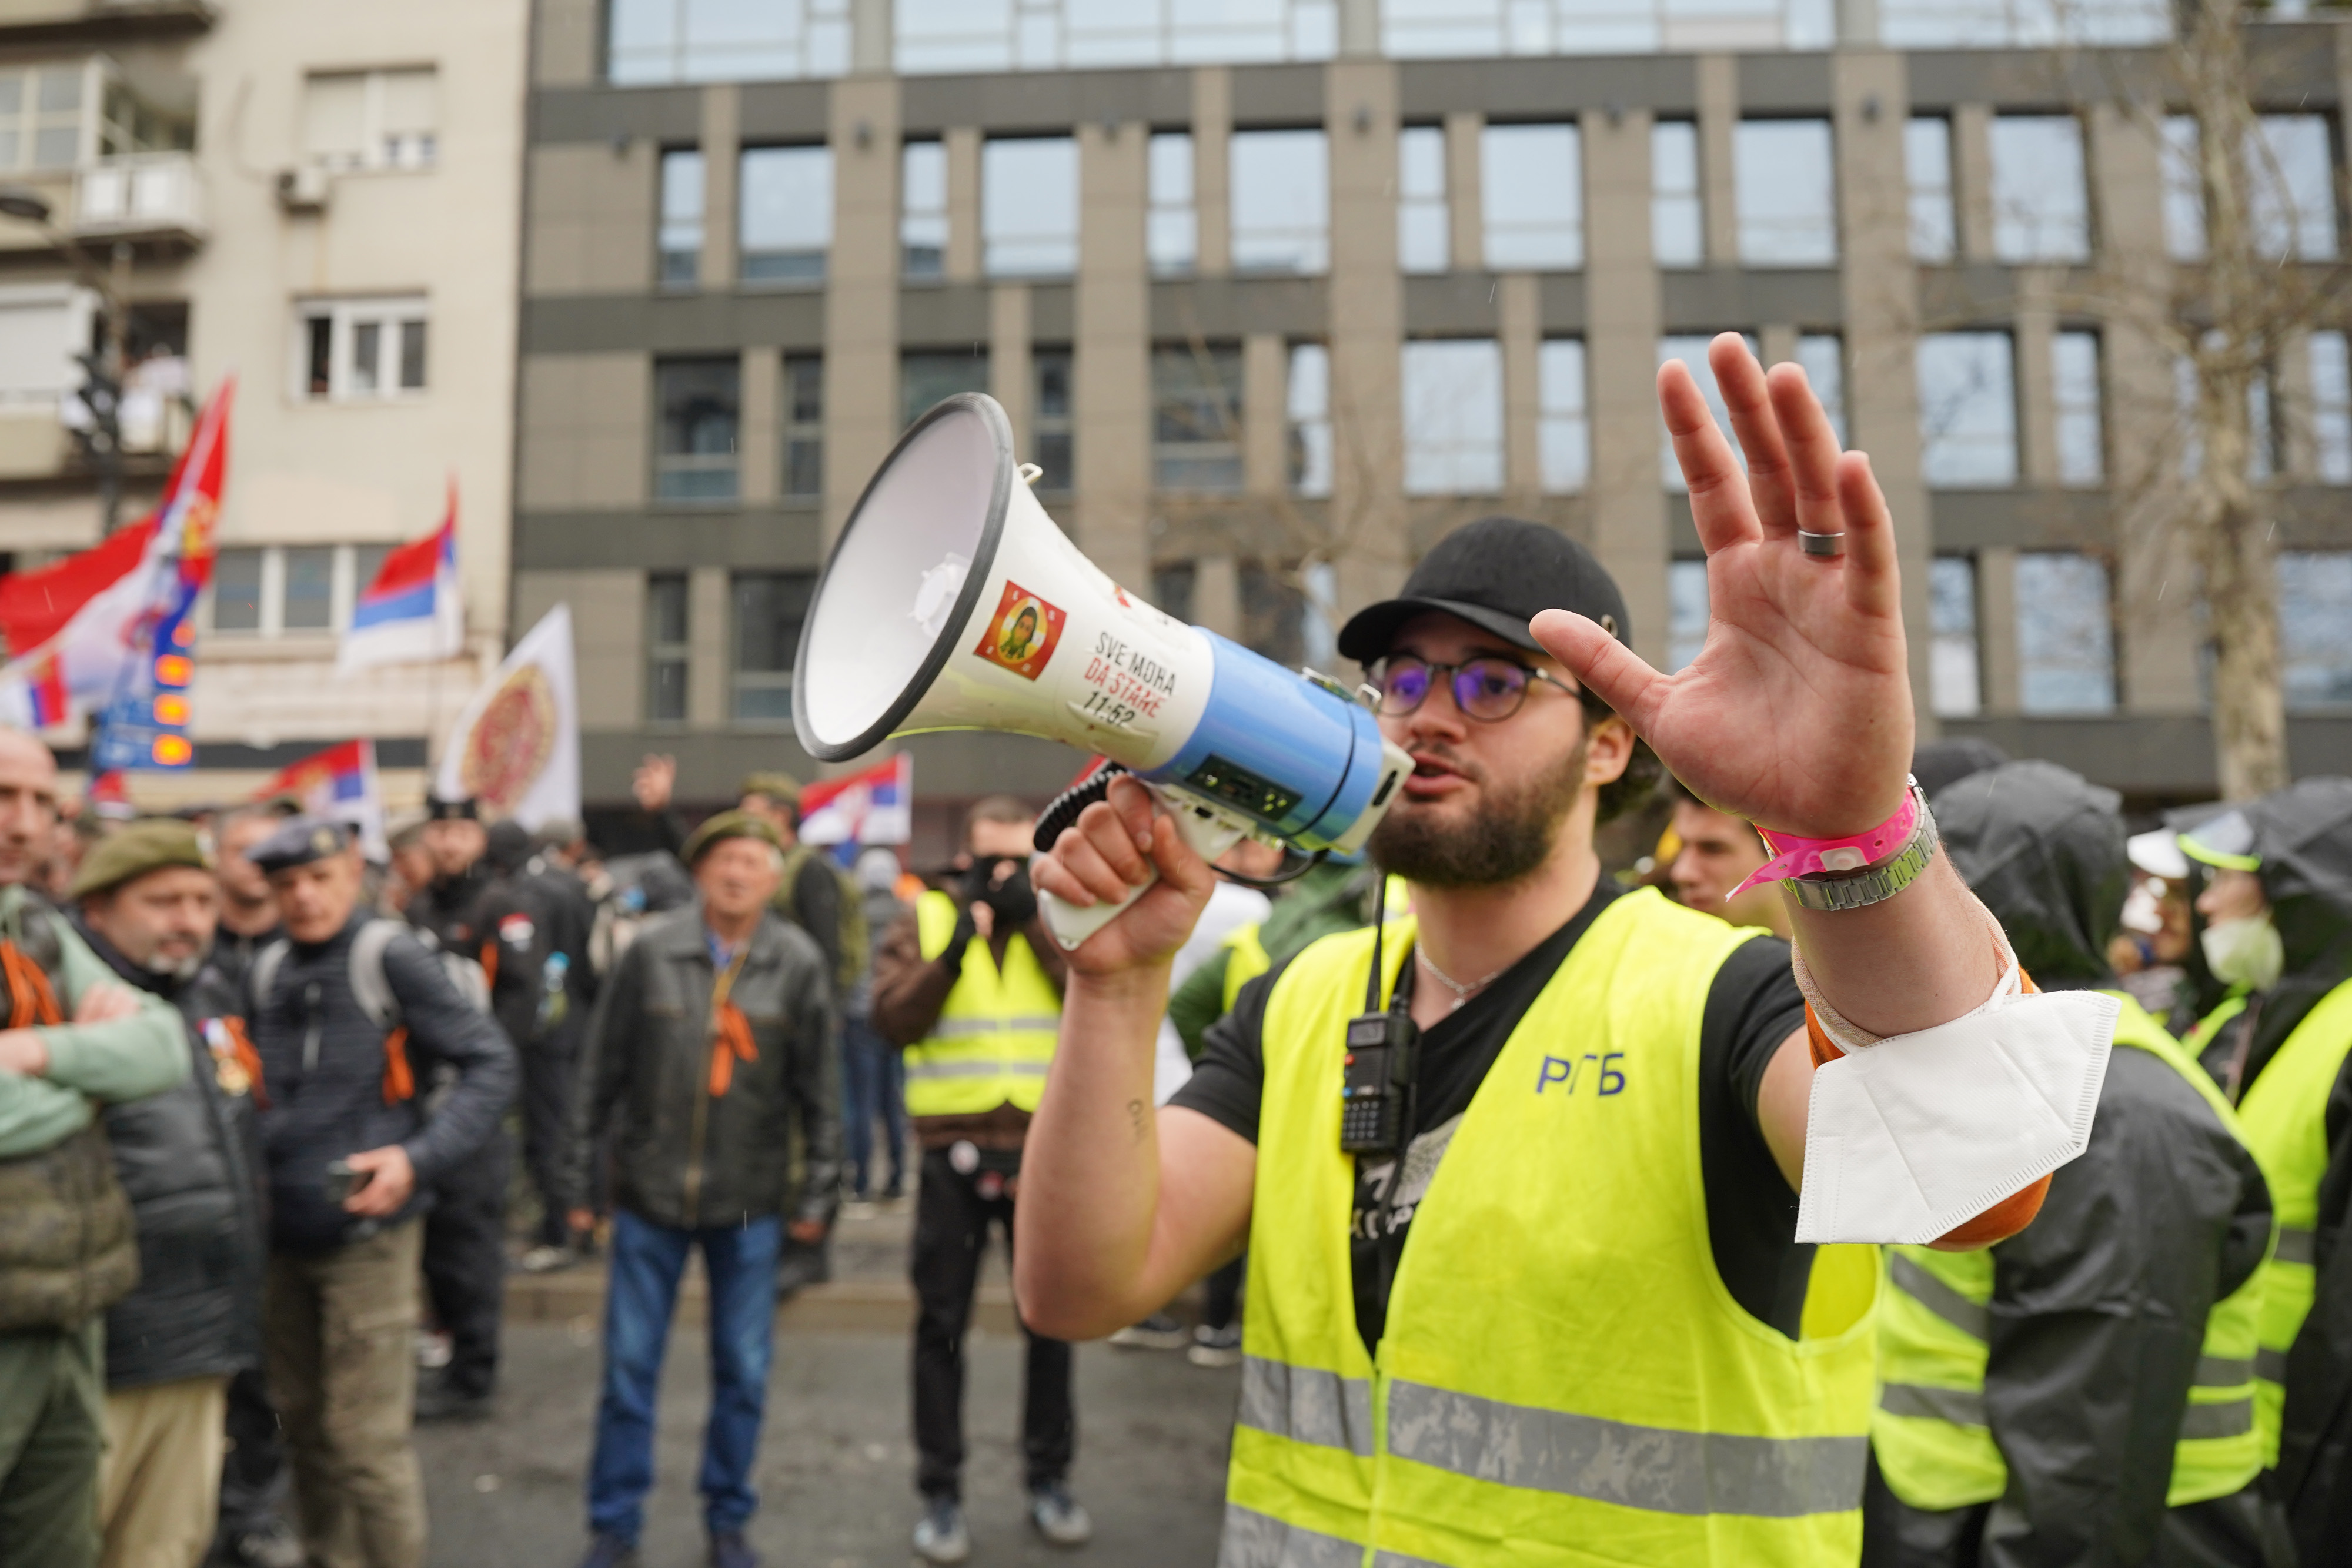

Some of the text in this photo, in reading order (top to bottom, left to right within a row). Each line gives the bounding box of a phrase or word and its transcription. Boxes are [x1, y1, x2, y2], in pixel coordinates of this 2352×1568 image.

[1085, 657, 1166, 718] DA STANE
[1096, 631, 1175, 696] SVE MORA
[1084, 691, 1135, 727] 11:52
[1536, 1052, 1625, 1096] РГБ
